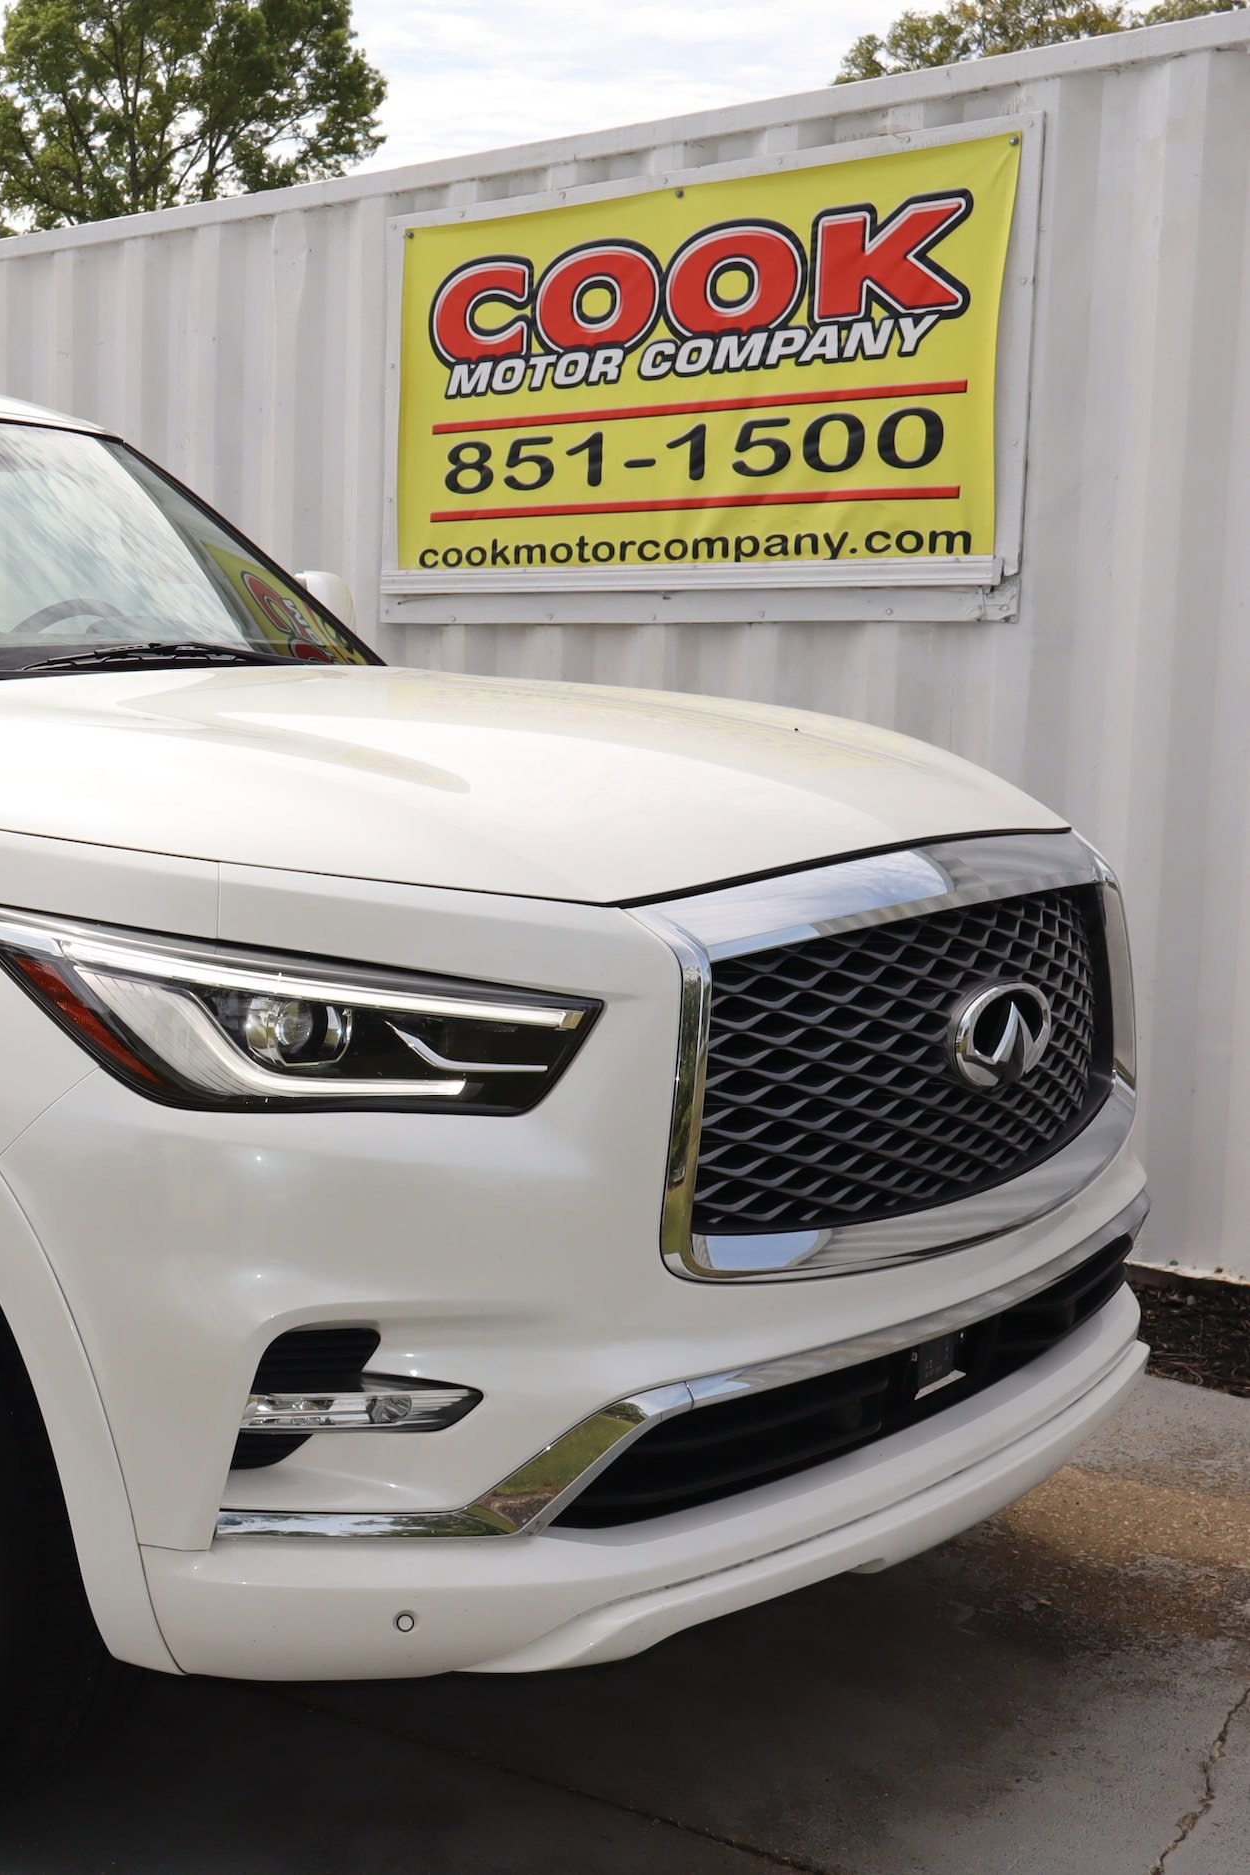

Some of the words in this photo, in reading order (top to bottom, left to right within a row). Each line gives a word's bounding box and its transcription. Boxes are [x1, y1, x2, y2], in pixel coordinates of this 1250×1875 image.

[431, 188, 972, 366] COOK
[445, 346, 625, 398] MOTOR
[638, 314, 941, 380] COMPANY
[445, 406, 944, 494] 851-1500
[418, 528, 972, 568] cookmotorcompany.com
